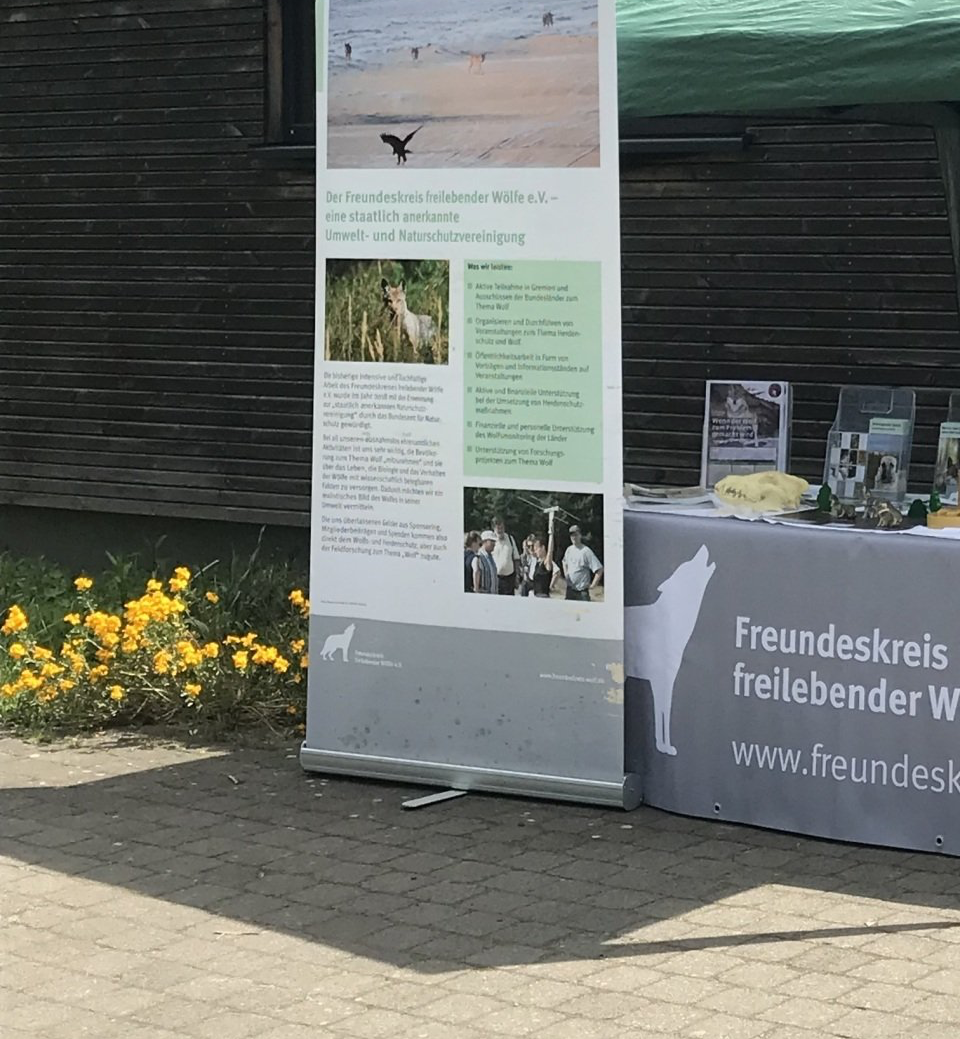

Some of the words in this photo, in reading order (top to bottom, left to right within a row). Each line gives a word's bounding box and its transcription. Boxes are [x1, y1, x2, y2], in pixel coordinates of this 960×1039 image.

[326, 191, 342, 203] Der
[346, 190, 423, 203] Freundeskreis
[426, 191, 488, 203] freilebender
[492, 190, 524, 204] Wölfe
[527, 192, 548, 204] e.V.
[325, 211, 346, 222] eine
[349, 210, 399, 222] staatlich
[403, 211, 459, 223] anerkannte
[325, 229, 369, 242] Umwelt-
[373, 229, 395, 242] und
[399, 229, 525, 246] Naturschutzvereinigung
[735, 616, 948, 670] Freundeskreis
[733, 664, 922, 717] freilebender
